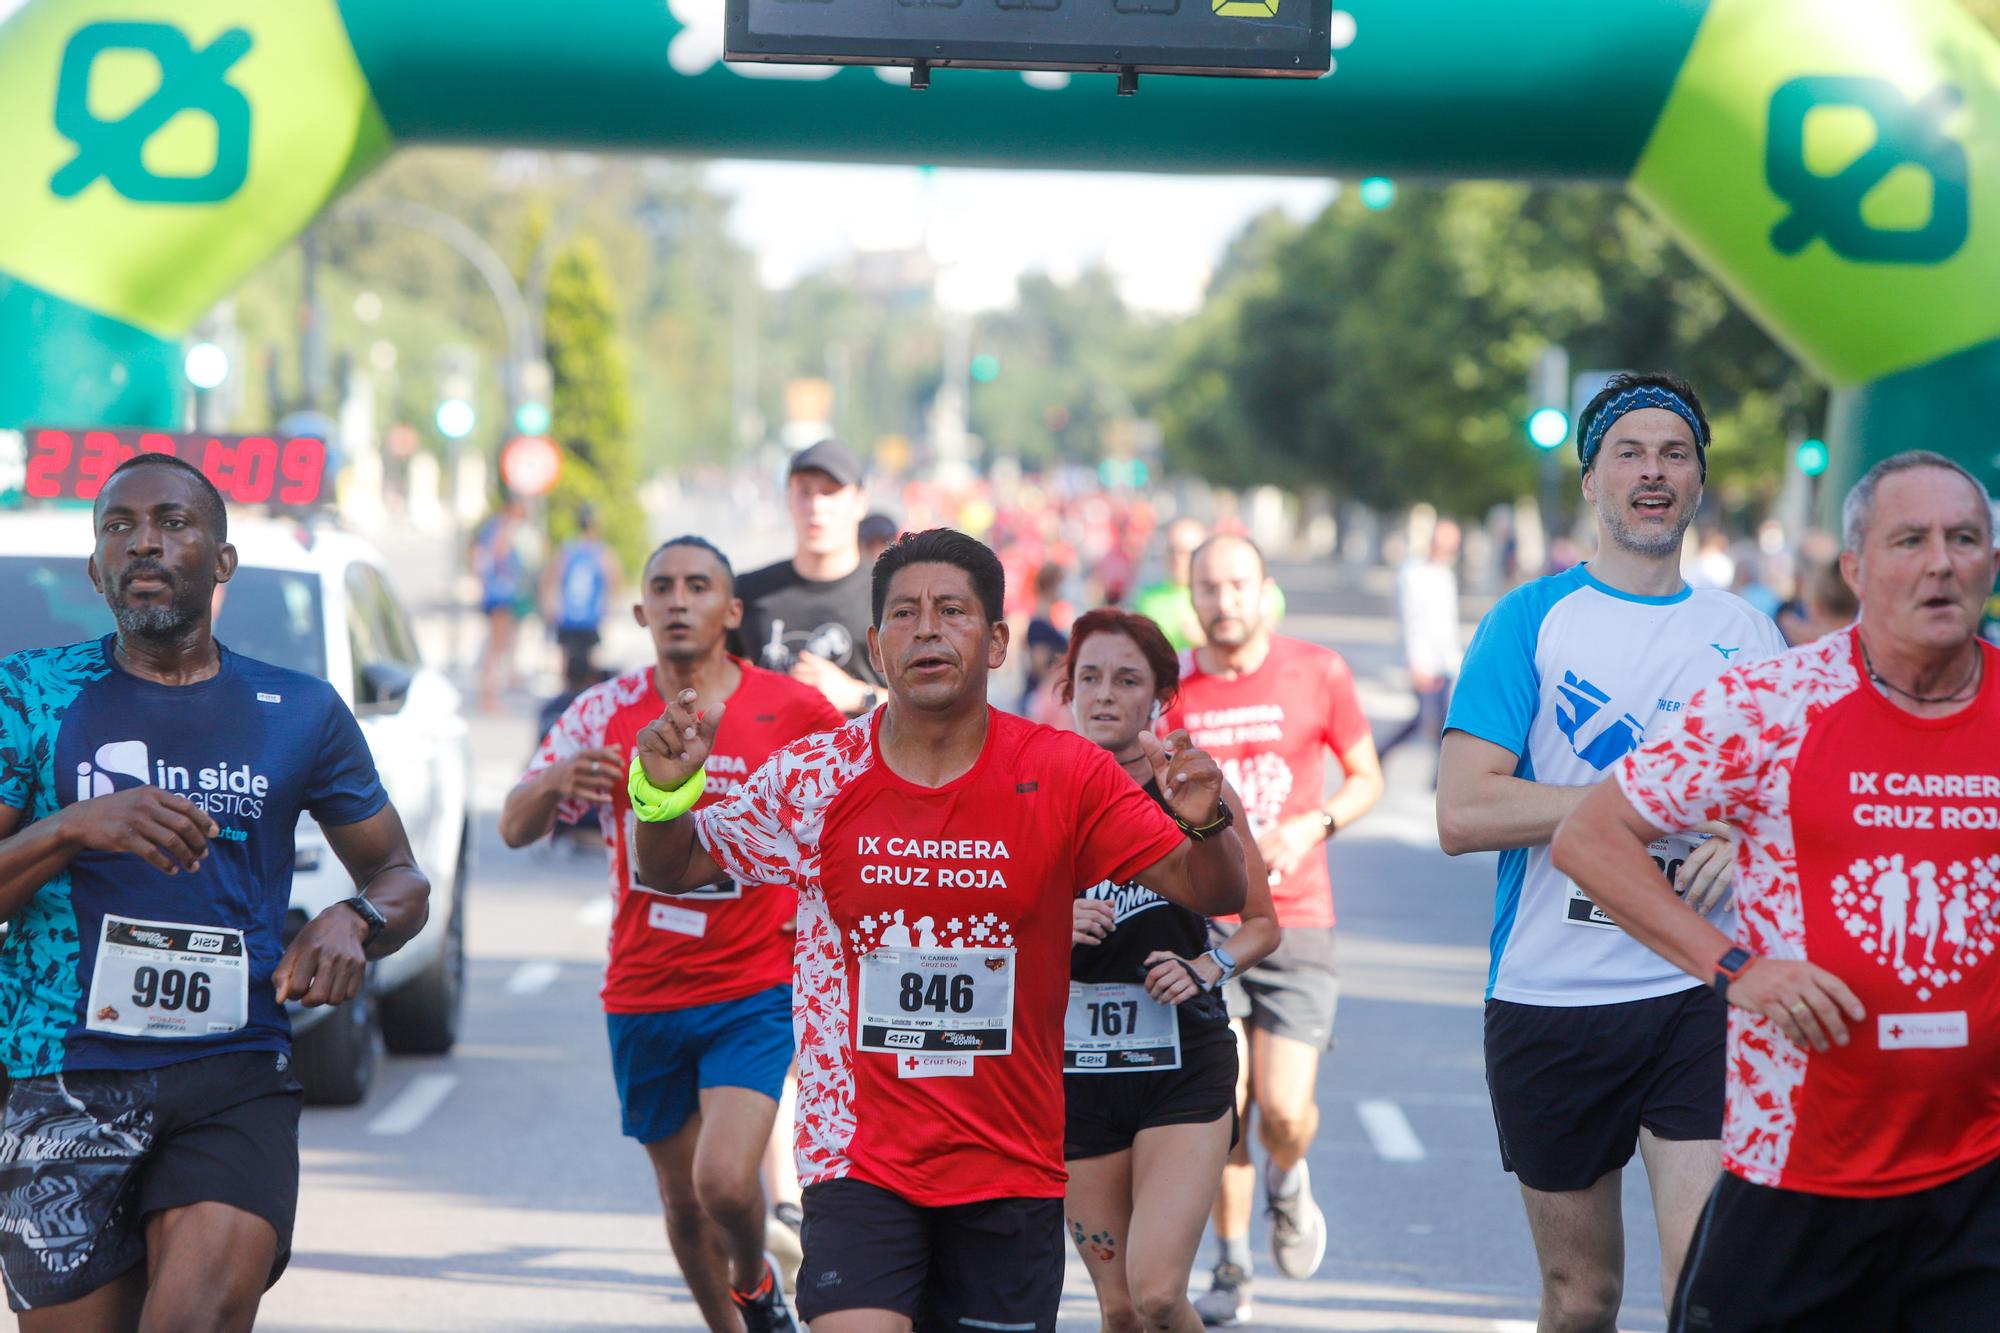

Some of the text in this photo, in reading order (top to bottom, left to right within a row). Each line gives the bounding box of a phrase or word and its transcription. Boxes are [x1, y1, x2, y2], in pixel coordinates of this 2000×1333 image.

[1656, 698, 1686, 712] THER
[156, 759, 269, 797] in side
[1849, 771, 2000, 798] IX CARRER
[1853, 803, 2000, 830] CRUZ ROJ
[857, 836, 1010, 859] IX CARRERA
[860, 865, 1008, 889] CRUZ ROJA
[899, 972, 974, 1013] 846
[1087, 1000, 1138, 1036] 767
[888, 1034, 920, 1045] 42K
[923, 1058, 967, 1067] Cruz Roja
[1079, 1055, 1104, 1064] 42K
